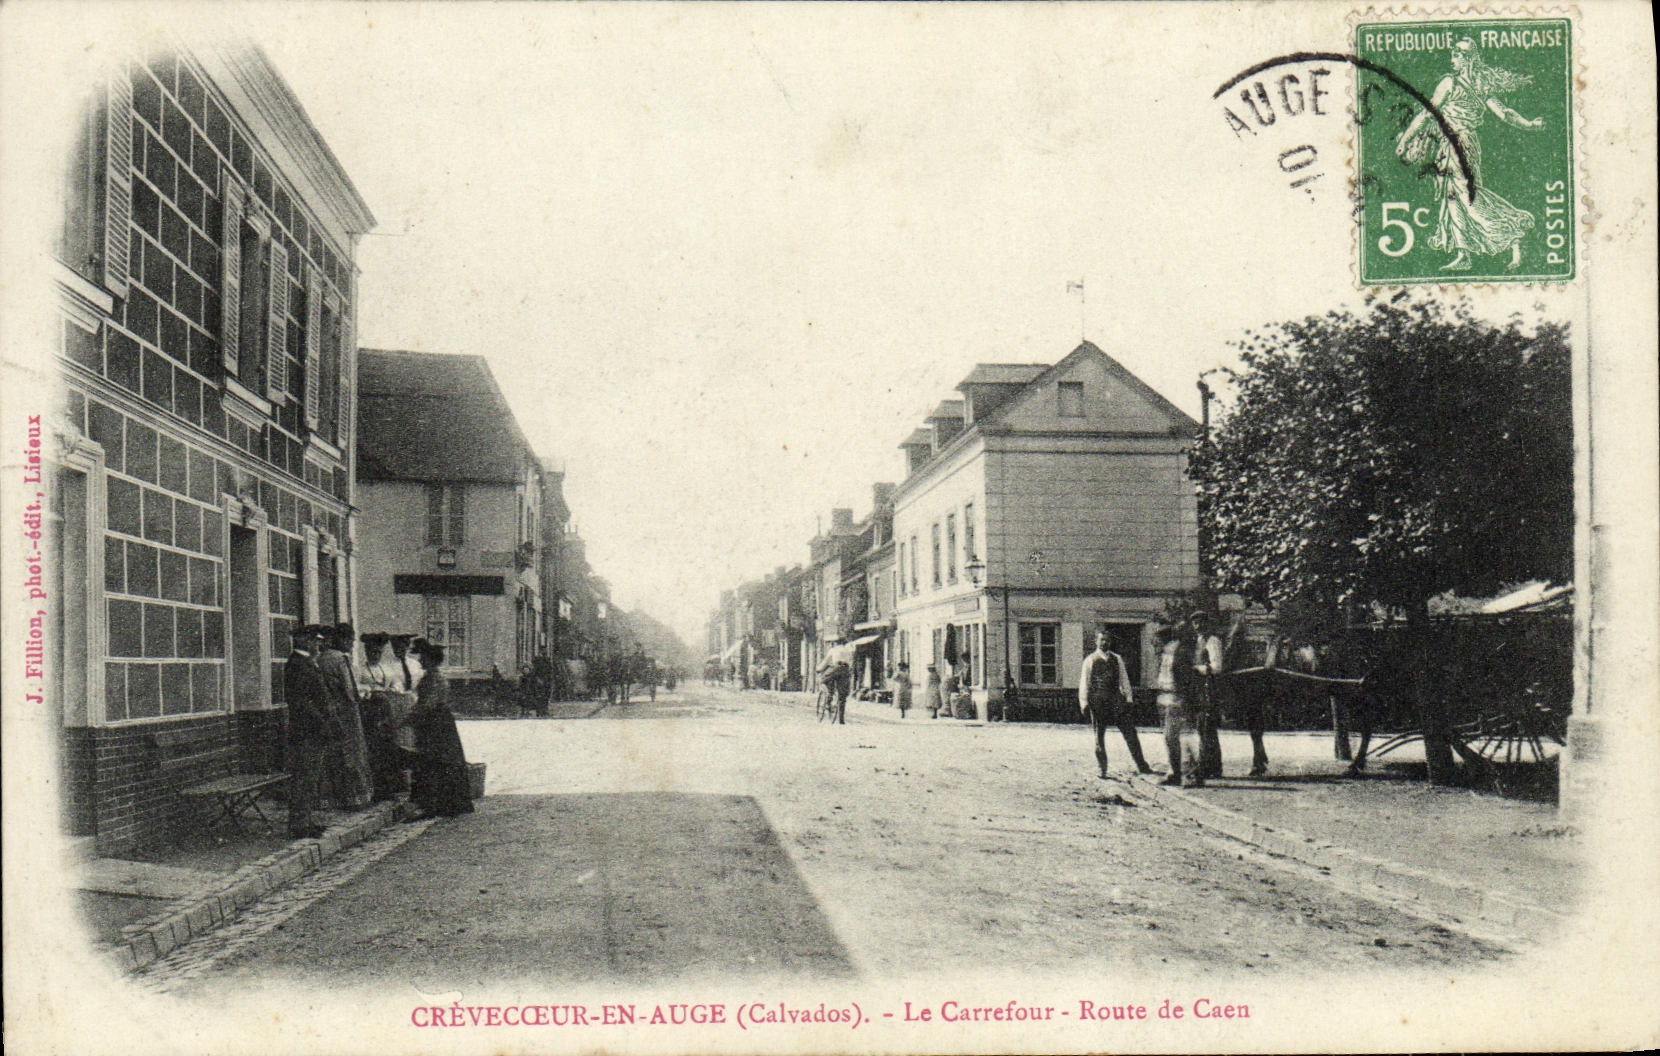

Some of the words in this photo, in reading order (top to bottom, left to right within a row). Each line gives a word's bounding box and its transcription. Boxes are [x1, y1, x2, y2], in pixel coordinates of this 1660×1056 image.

[1480, 28, 1563, 50] FRANÇAISE
[1223, 67, 1332, 140] AUGE
[1546, 180, 1570, 265] POSTES
